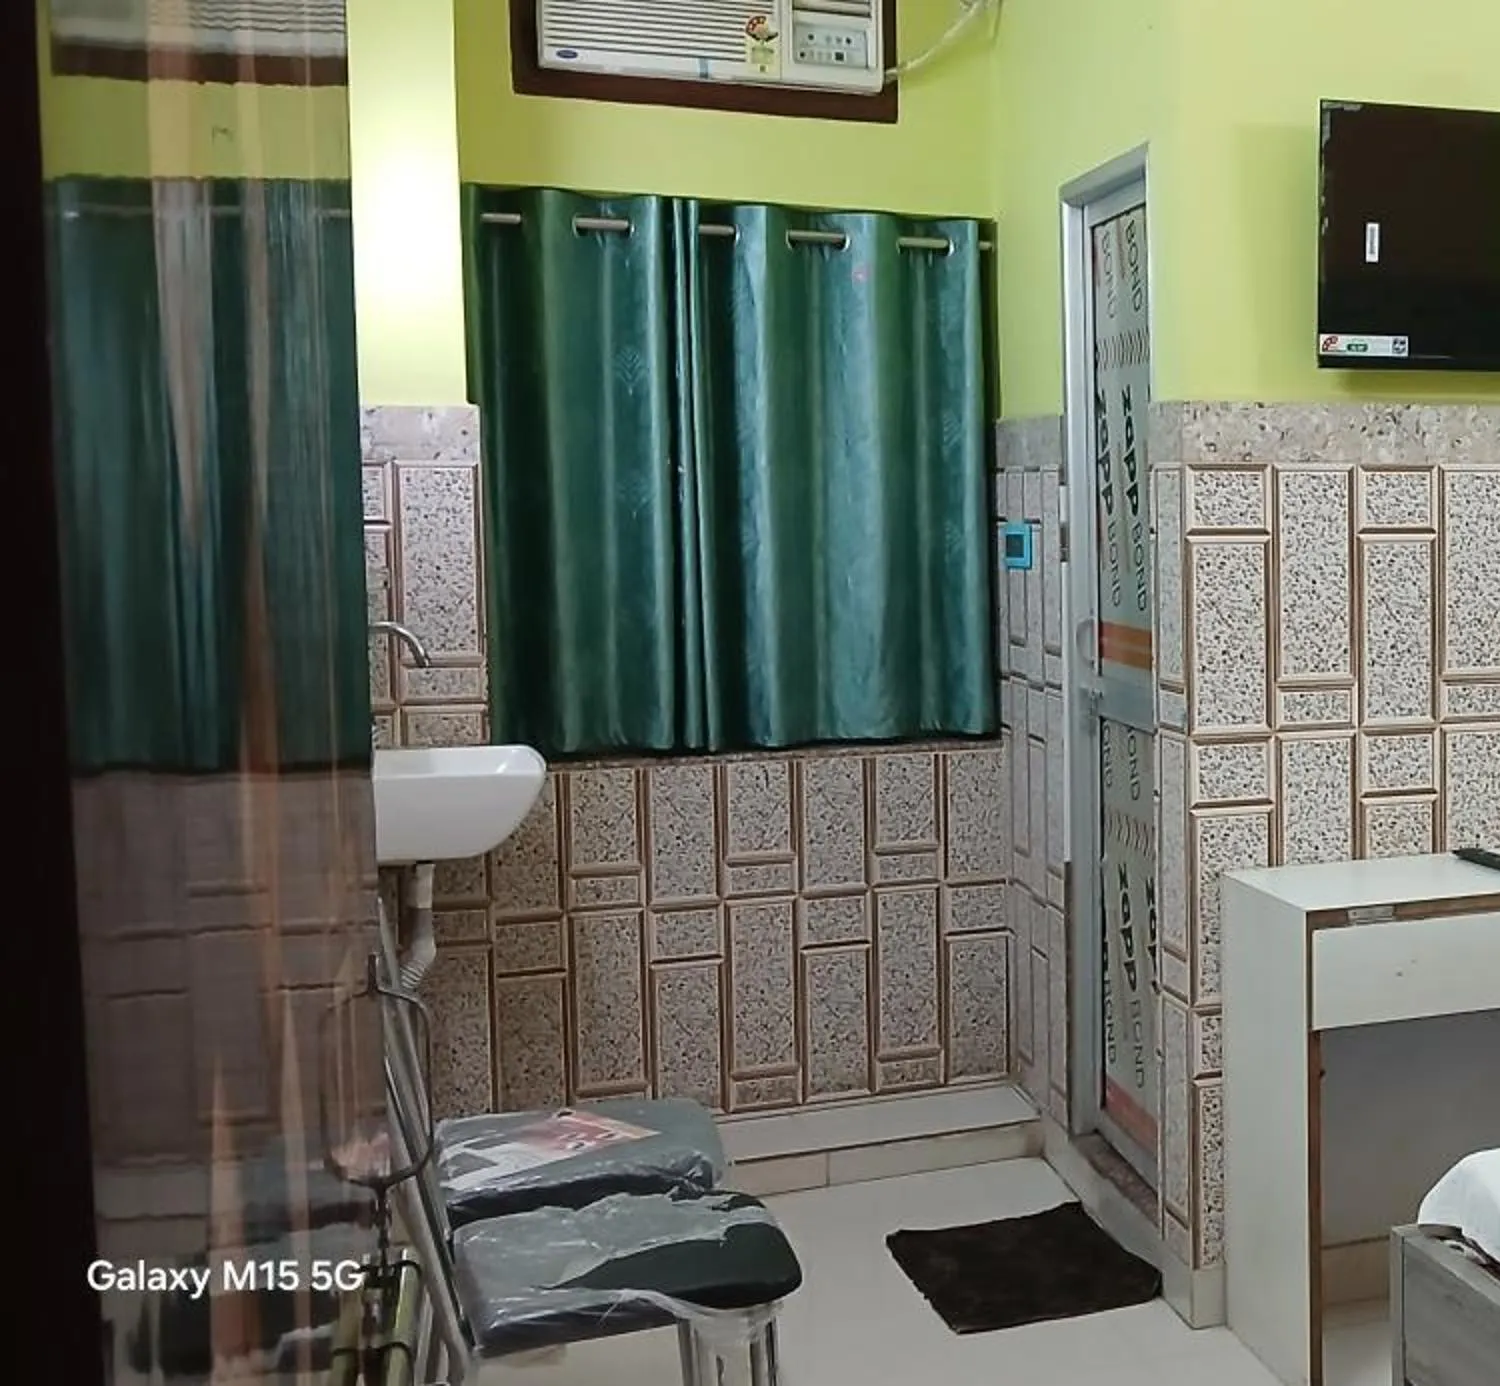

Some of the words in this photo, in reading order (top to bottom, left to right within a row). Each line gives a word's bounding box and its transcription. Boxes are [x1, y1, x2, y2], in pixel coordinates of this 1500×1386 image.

[1101, 231, 1117, 320] BOND
[1125, 219, 1144, 312] BOND
[1121, 383, 1139, 517] zapp
[1131, 521, 1148, 612] BOND
[1108, 521, 1122, 608] BOND
[1118, 863, 1138, 992] zapp
[1129, 999, 1146, 1089] BOND
